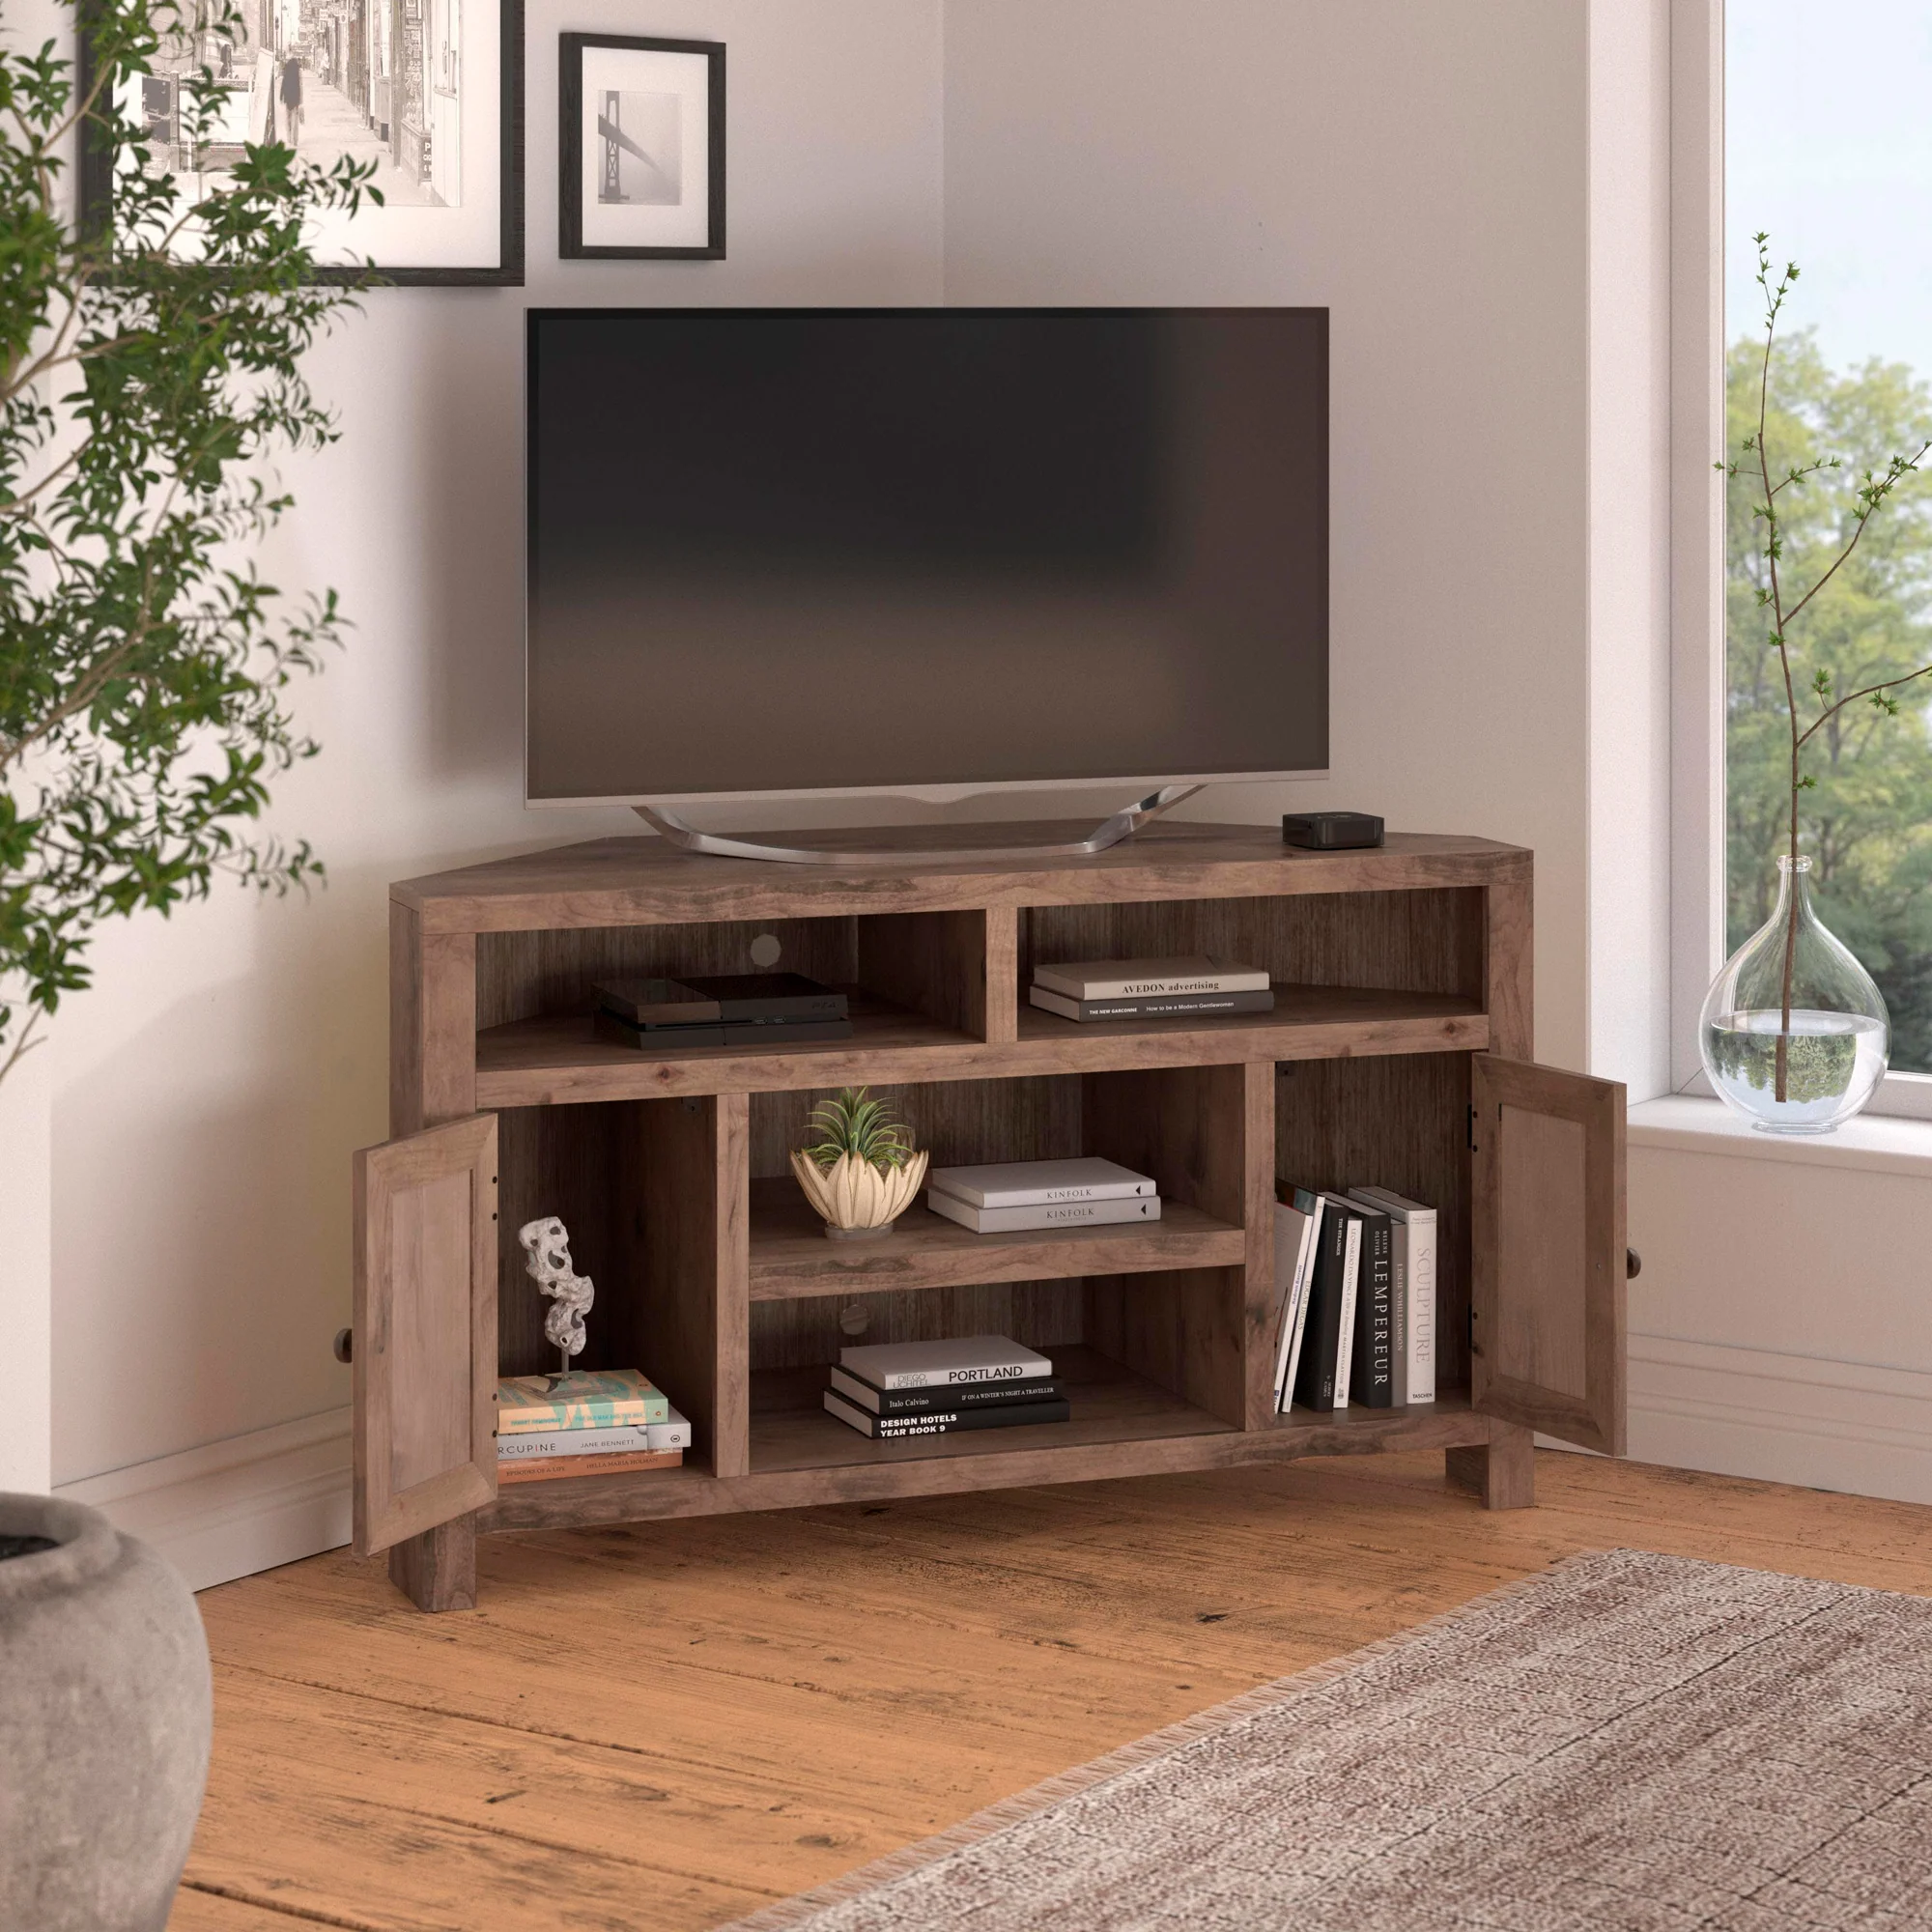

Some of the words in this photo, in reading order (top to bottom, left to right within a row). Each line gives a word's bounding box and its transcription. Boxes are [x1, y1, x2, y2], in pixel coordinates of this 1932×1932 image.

[1122, 983, 1165, 994] AVEDON
[1168, 980, 1219, 991] advertising
[1046, 1188, 1092, 1199] KINFOLK
[1046, 1208, 1094, 1219] KINFOLK
[1348, 1228, 1356, 1264] LEONARDO
[1416, 1247, 1431, 1363] SCULPTURE
[1375, 1260, 1388, 1385] LEMPEREUR
[897, 1373, 926, 1382] DIEGO
[949, 1366, 1023, 1382] PORTLAND
[980, 1390, 1005, 1399] WINTER'S
[889, 1400, 904, 1408] Italo
[905, 1398, 929, 1406] Calvino
[880, 1417, 918, 1428] DESIGN
[920, 1414, 957, 1424] HOTELS
[880, 1428, 906, 1437] YEAR
[909, 1425, 937, 1435] BOOK
[630, 1457, 659, 1465] HOLMAN
[506, 1468, 536, 1477] EPISODES
